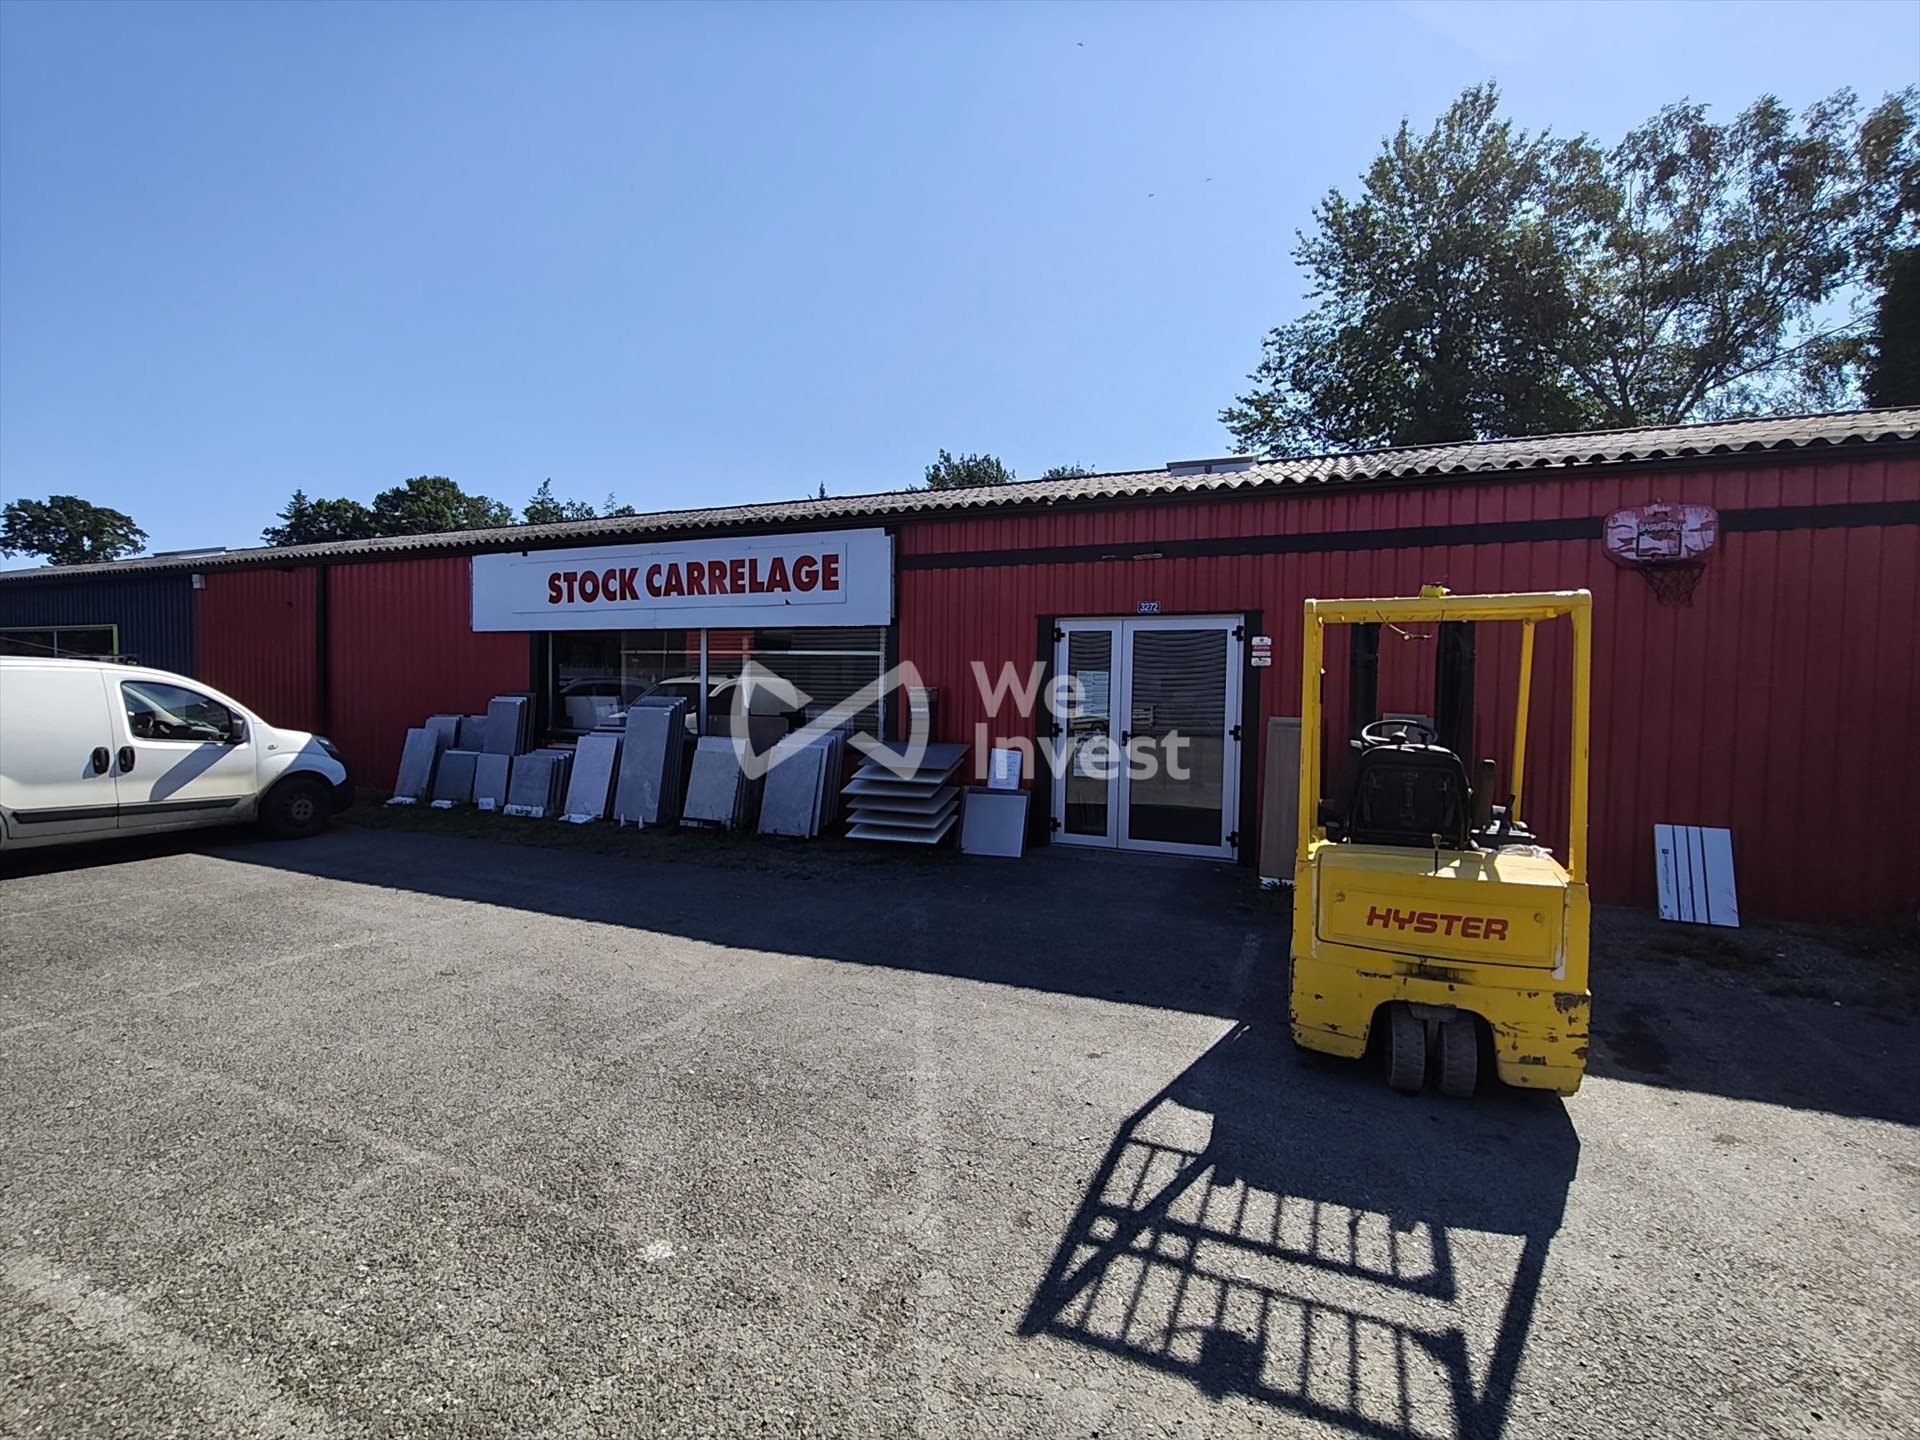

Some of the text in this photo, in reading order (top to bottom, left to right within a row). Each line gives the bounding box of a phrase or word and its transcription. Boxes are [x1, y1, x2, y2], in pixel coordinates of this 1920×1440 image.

[1638, 521, 1682, 532] BASKETBALL
[548, 554, 840, 604] STOCK CARRELAGE
[1139, 602, 1159, 612] 3272
[1366, 905, 1510, 941] HYSTER
